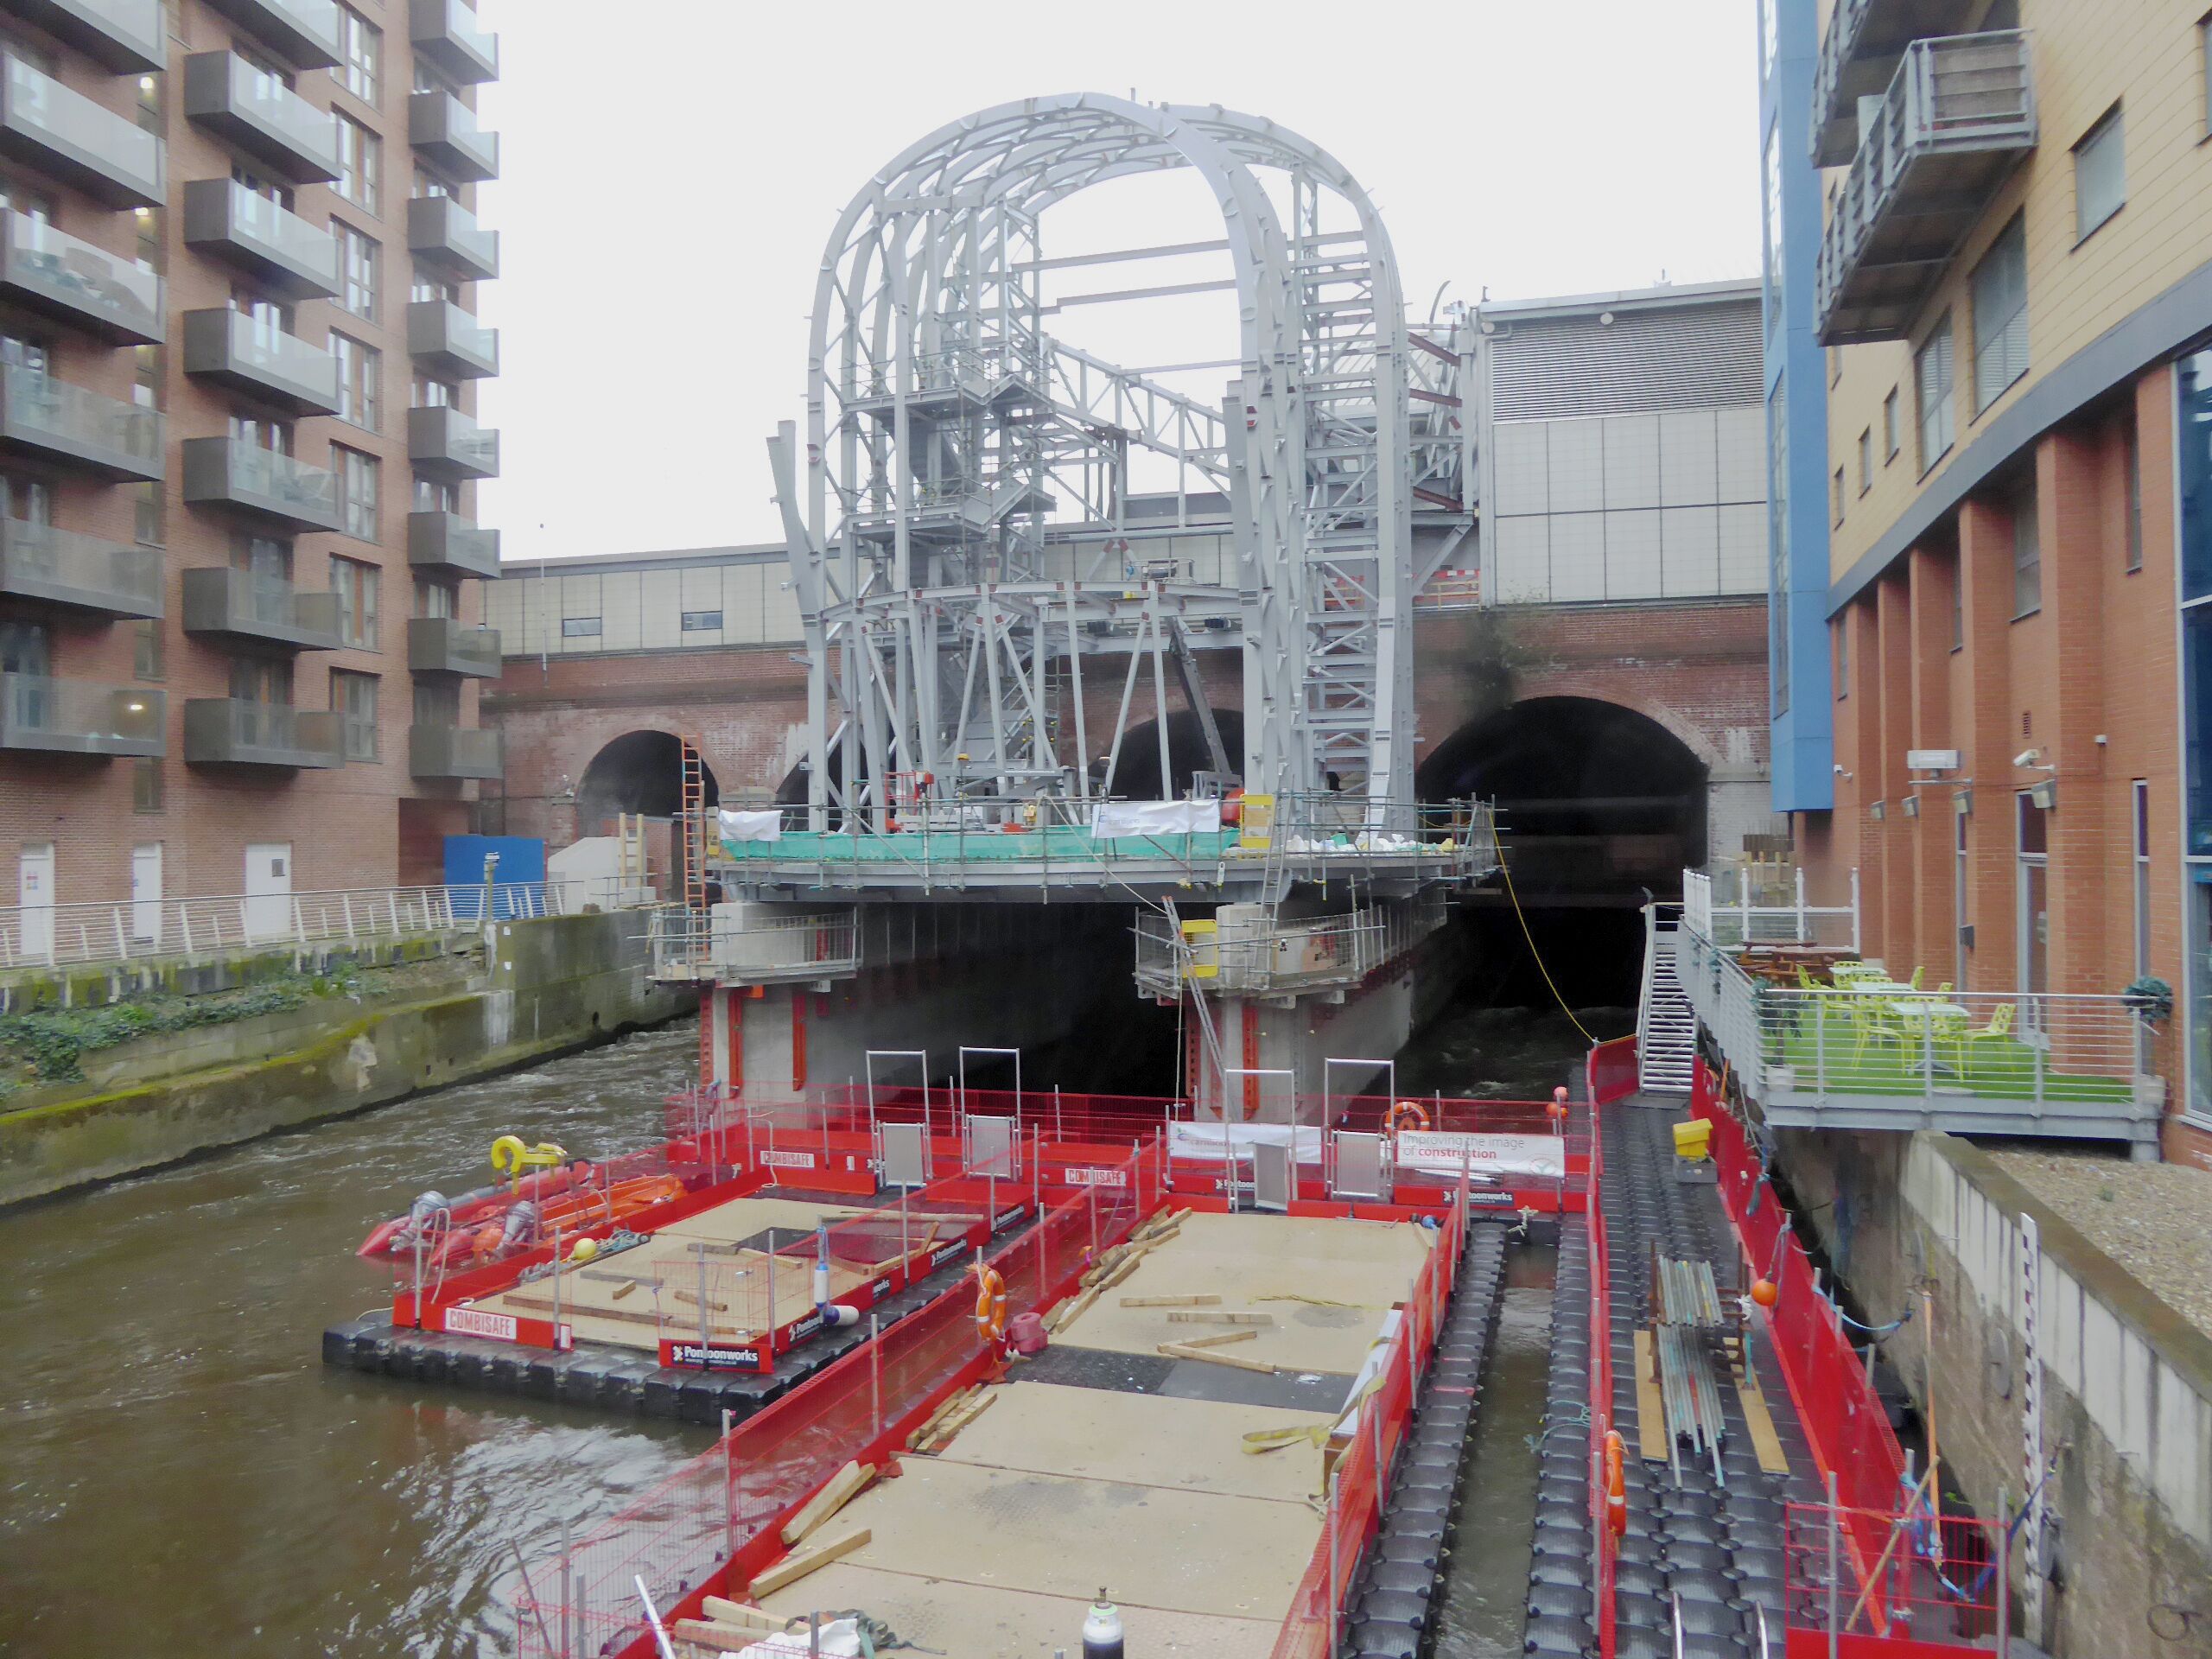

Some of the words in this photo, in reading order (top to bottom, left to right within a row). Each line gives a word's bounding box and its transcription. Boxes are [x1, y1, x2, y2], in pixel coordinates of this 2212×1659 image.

[1403, 1132, 1464, 1147] Improving
[1465, 1135, 1484, 1147] the
[1489, 1137, 1525, 1150] image
[1403, 1147, 1415, 1156] of
[1069, 1169, 1121, 1184] COMISAFE
[449, 1310, 512, 1337] COMBISAFE
[683, 1345, 759, 1362] Ponoonworks
